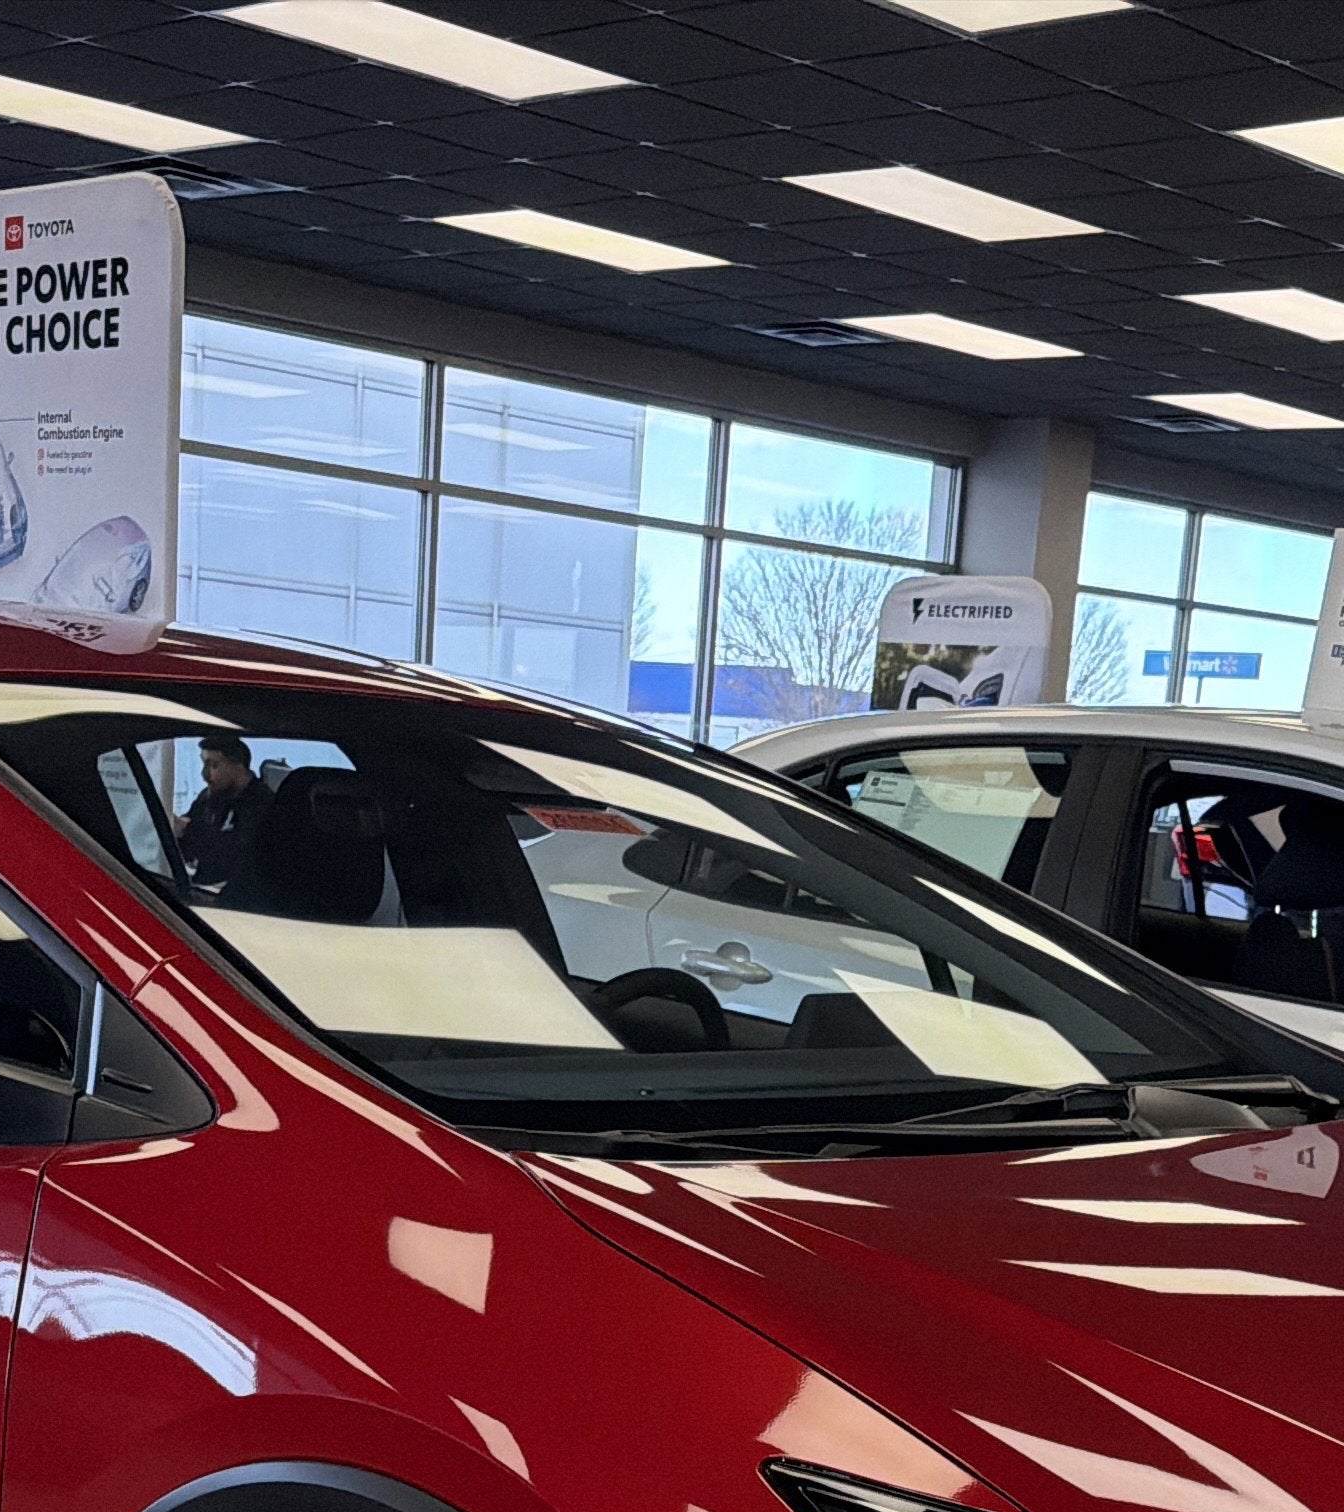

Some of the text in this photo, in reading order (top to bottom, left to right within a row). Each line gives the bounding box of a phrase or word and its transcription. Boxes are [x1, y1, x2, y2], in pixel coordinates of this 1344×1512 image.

[27, 219, 74, 239] TOYOTA
[16, 257, 130, 306] POWER
[6, 308, 120, 354] CHOICE
[38, 409, 72, 424] Internal
[38, 425, 124, 442] Combustion Engine
[928, 604, 1013, 620] ELECTRIFIED
